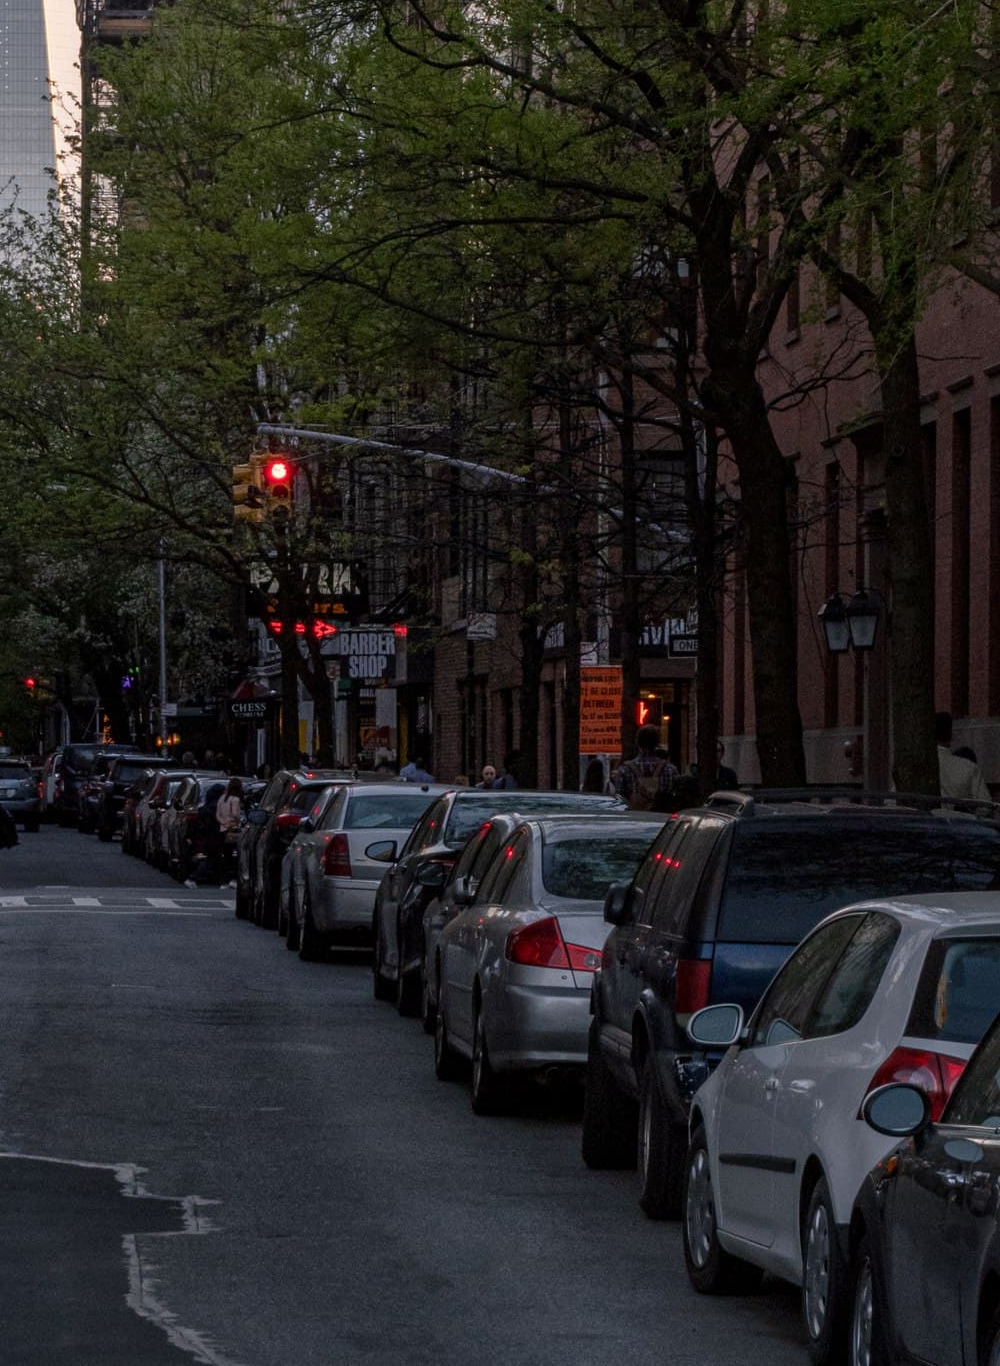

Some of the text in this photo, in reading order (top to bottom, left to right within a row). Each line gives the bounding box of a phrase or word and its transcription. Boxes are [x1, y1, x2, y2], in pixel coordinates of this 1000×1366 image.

[249, 562, 361, 595] PRK
[339, 632, 396, 654] BARBER
[349, 655, 388, 678] SHOP
[231, 702, 267, 713] CHESS
